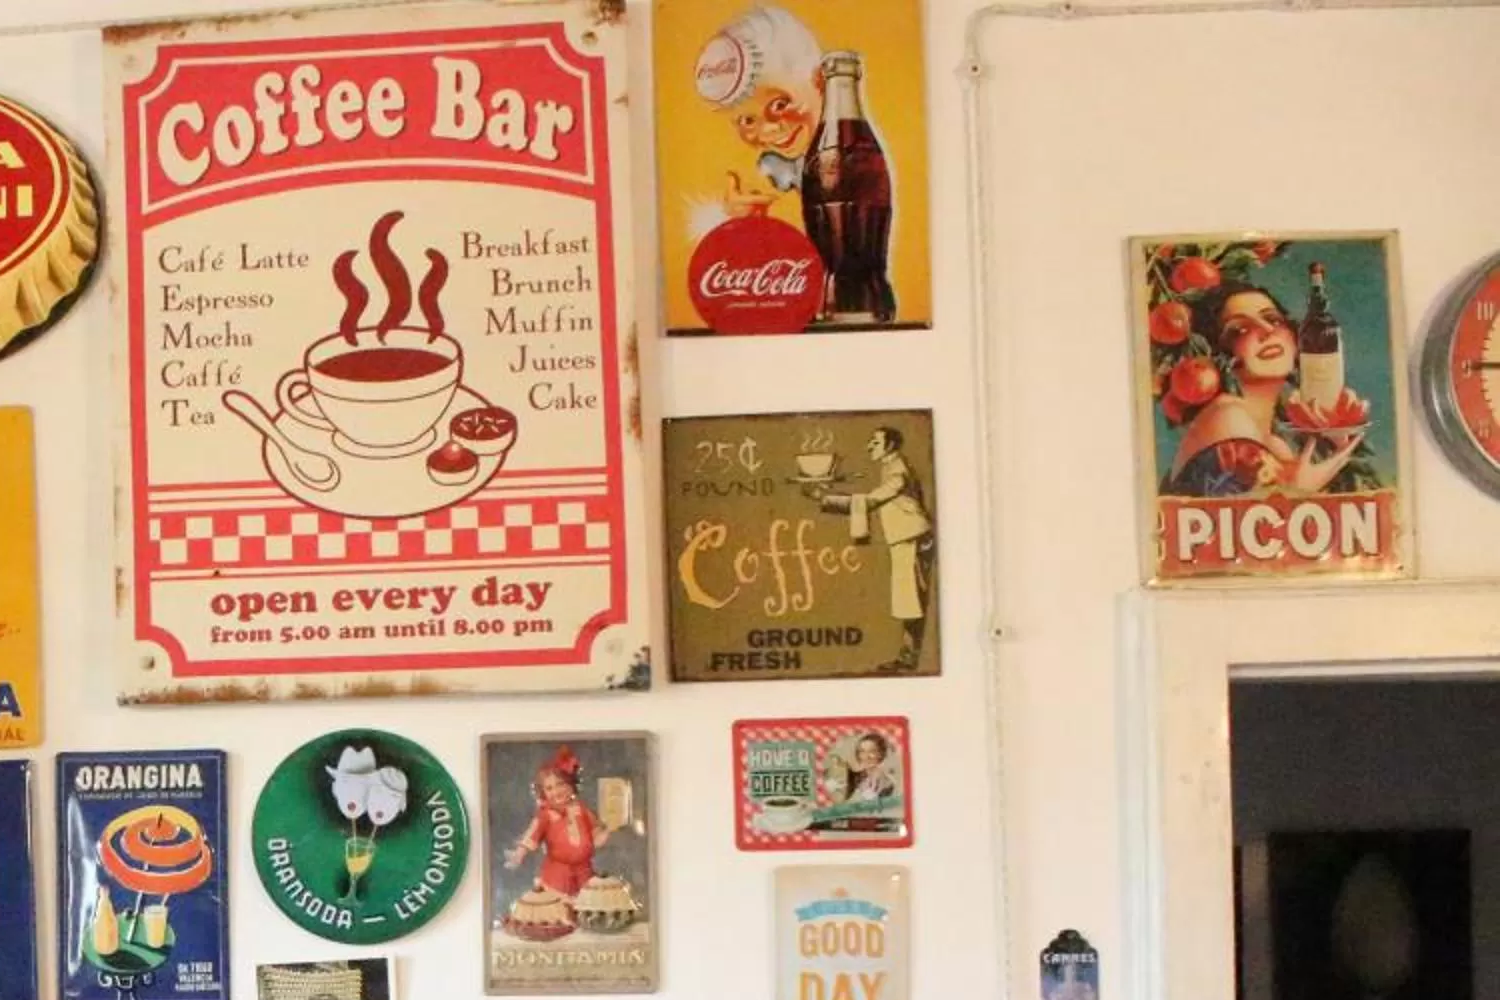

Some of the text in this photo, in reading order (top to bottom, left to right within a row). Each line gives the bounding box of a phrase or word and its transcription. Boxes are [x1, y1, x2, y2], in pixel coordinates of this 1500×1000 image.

[156, 56, 574, 187] Coffee Bar
[157, 242, 309, 274] Café Latte
[459, 227, 591, 260] Breakfast
[490, 264, 593, 298] Brunch
[699, 258, 815, 298] Coca-Cola
[159, 284, 275, 316] Espresso
[161, 320, 253, 350] Mocha
[483, 306, 594, 337] Muffin
[160, 358, 243, 389] Caffé
[508, 343, 597, 374] Juices
[526, 381, 598, 412] Cake
[161, 398, 216, 428] Tea
[1176, 501, 1380, 562] PICON
[677, 518, 863, 618] Coffee
[209, 575, 554, 623] open every day
[209, 615, 554, 645] from 5.00 am until 8.00 pm
[747, 626, 864, 649] GROUND
[709, 650, 803, 672] FRESH
[75, 763, 204, 791] ORANGINA
[751, 773, 810, 793] COFFEE
[267, 789, 455, 930] ORANSODA LEMONSODA
[799, 920, 885, 959] GOOD
